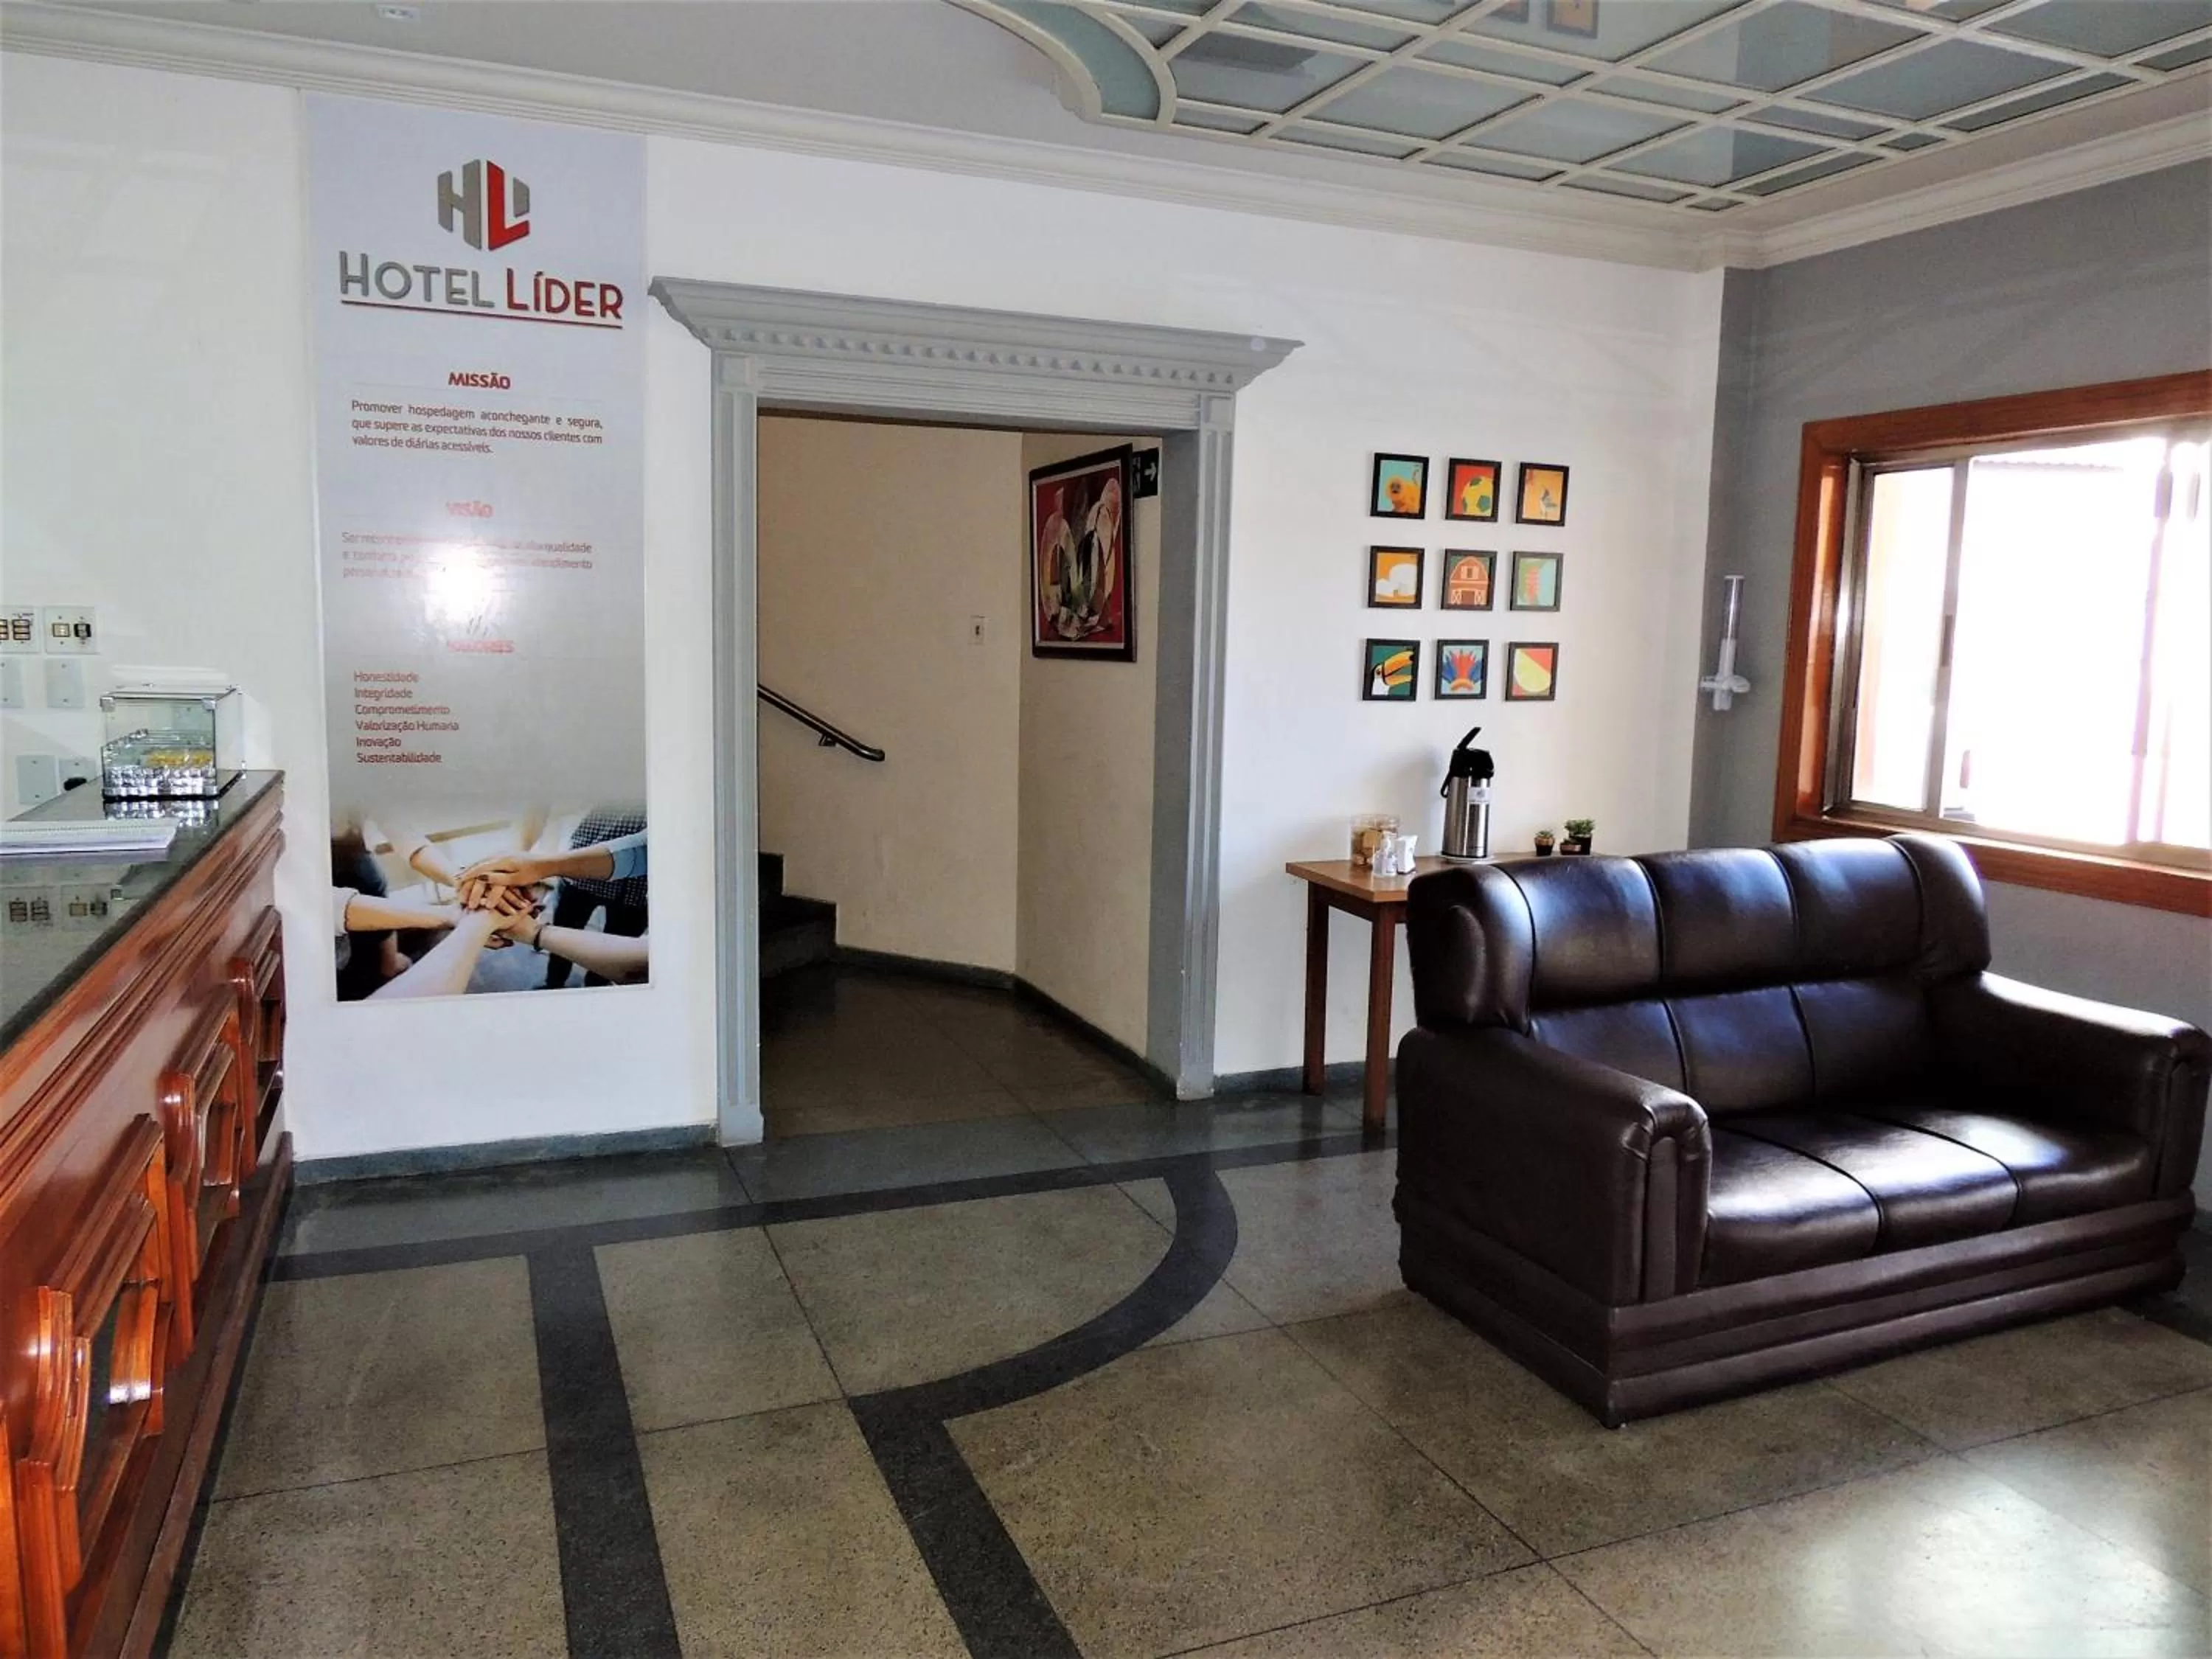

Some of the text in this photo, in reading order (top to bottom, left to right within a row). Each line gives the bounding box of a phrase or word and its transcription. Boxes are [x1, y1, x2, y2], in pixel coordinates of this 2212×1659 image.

[339, 251, 624, 319] HOTEL LÍDER
[448, 372, 511, 390] MISSÃO
[352, 400, 602, 430] Promover hospedagem aconchegante e segura,
[352, 420, 602, 444] que supere as expectativas dos nossos clientes com
[352, 434, 390, 447] valores
[391, 436, 403, 448] de
[406, 437, 439, 450] diárias
[354, 670, 420, 683] Honestidade
[355, 687, 413, 701] Integridade
[355, 704, 451, 717] Comprometimento
[355, 719, 459, 733] Valorização Humana
[356, 737, 402, 748] Inovação
[357, 751, 442, 764] Sustentabilidade
